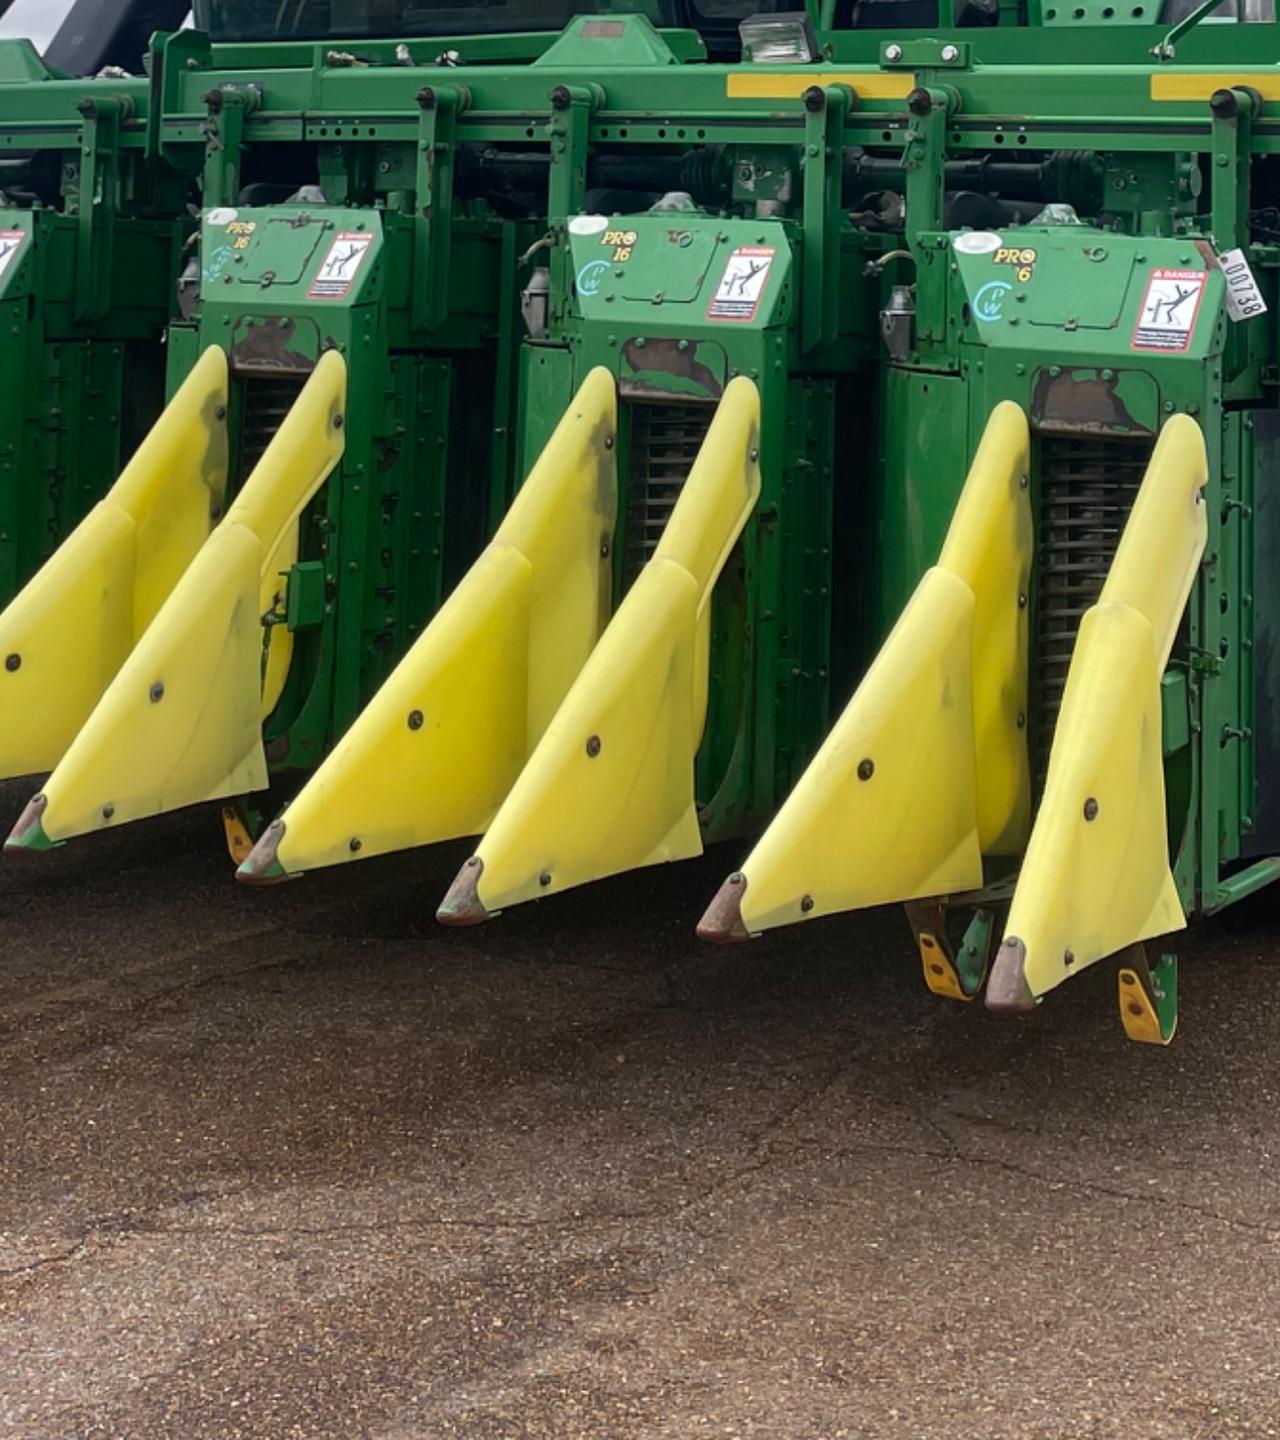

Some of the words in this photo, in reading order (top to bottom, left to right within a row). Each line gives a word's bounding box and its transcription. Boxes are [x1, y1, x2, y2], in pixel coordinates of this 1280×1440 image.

[600, 230, 638, 246] PRO
[992, 247, 1037, 265] PRO
[1225, 262, 1263, 316] 00738
